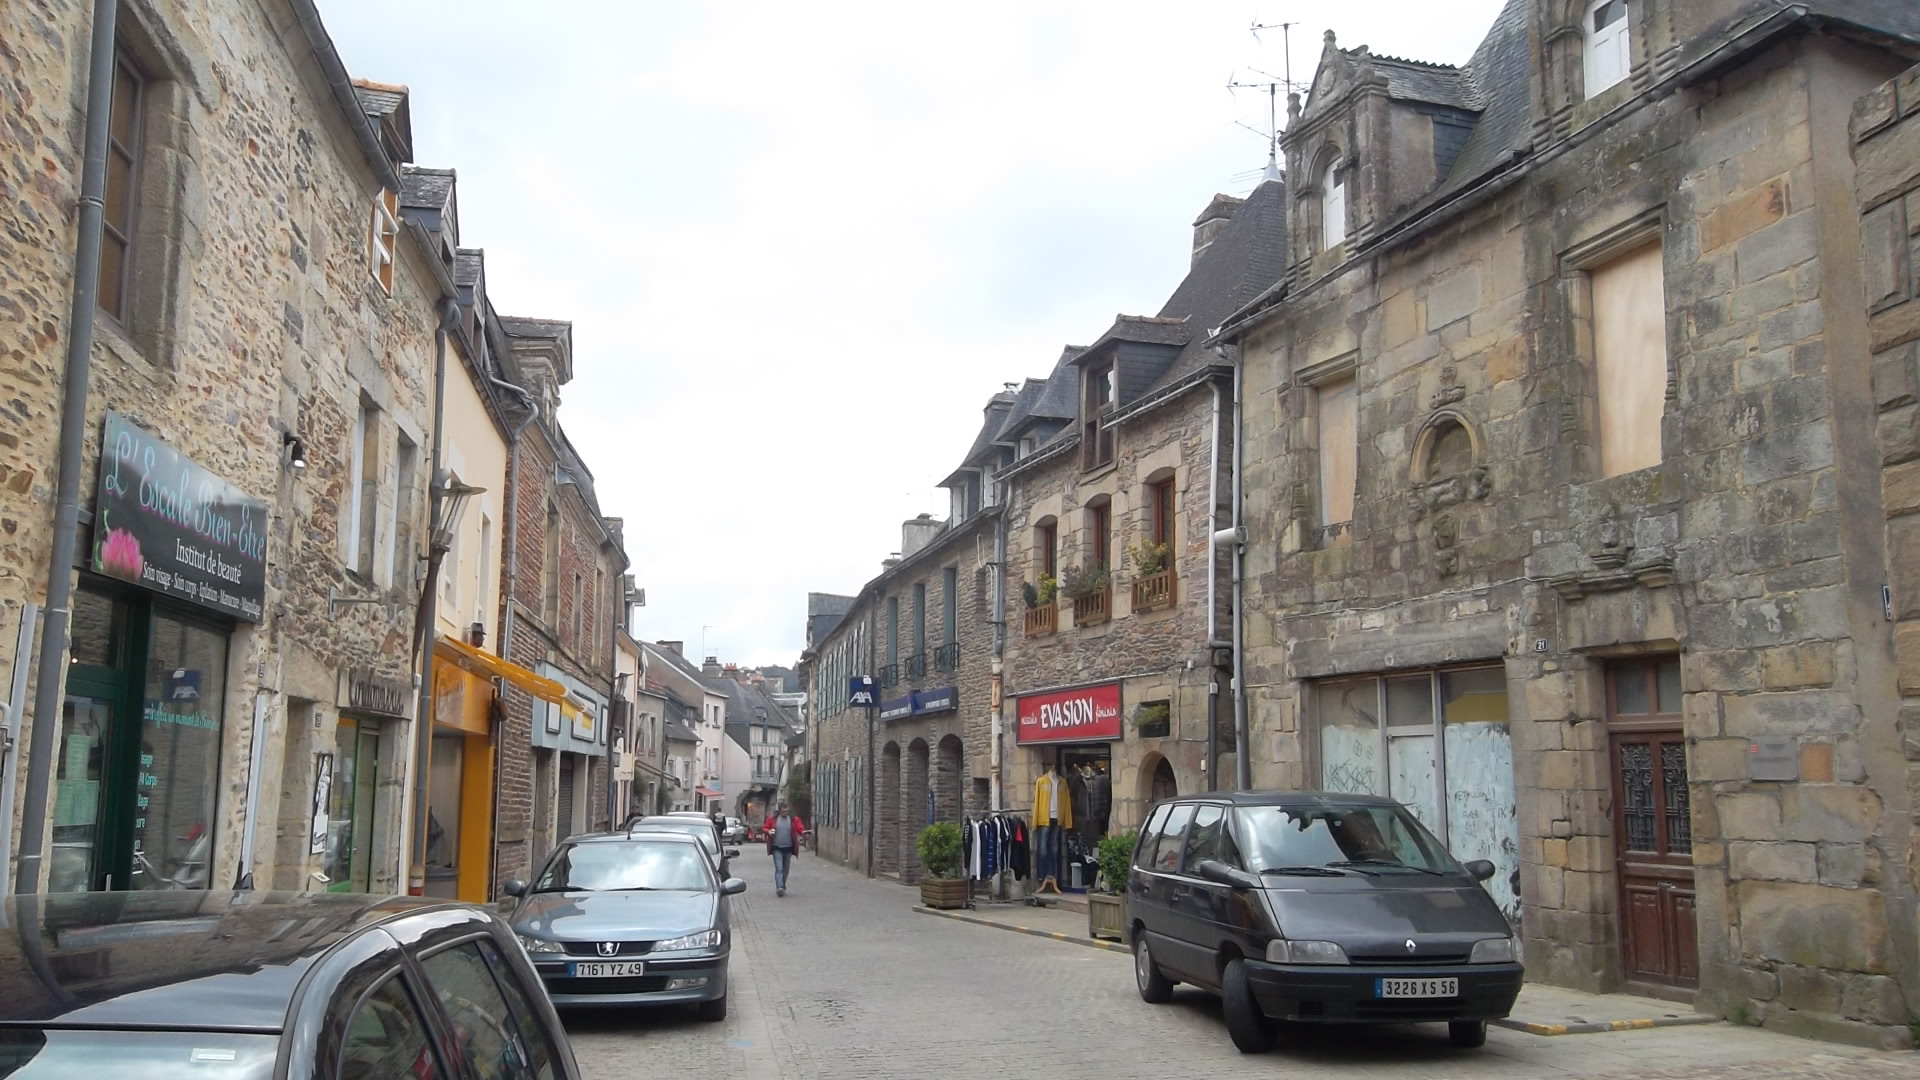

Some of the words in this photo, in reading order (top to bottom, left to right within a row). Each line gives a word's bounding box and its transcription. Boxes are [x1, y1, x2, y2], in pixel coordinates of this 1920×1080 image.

[139, 446, 193, 526] Escale
[176, 538, 206, 570] Institut
[206, 549, 217, 575] de
[217, 553, 242, 584] beauté
[849, 691, 873, 704] AXA
[1040, 696, 1093, 728] EVASION
[578, 964, 604, 976] 7161
[610, 964, 623, 975] YZ
[628, 963, 641, 975] 49
[1386, 981, 1417, 995] 3226
[1441, 980, 1455, 994] 56
